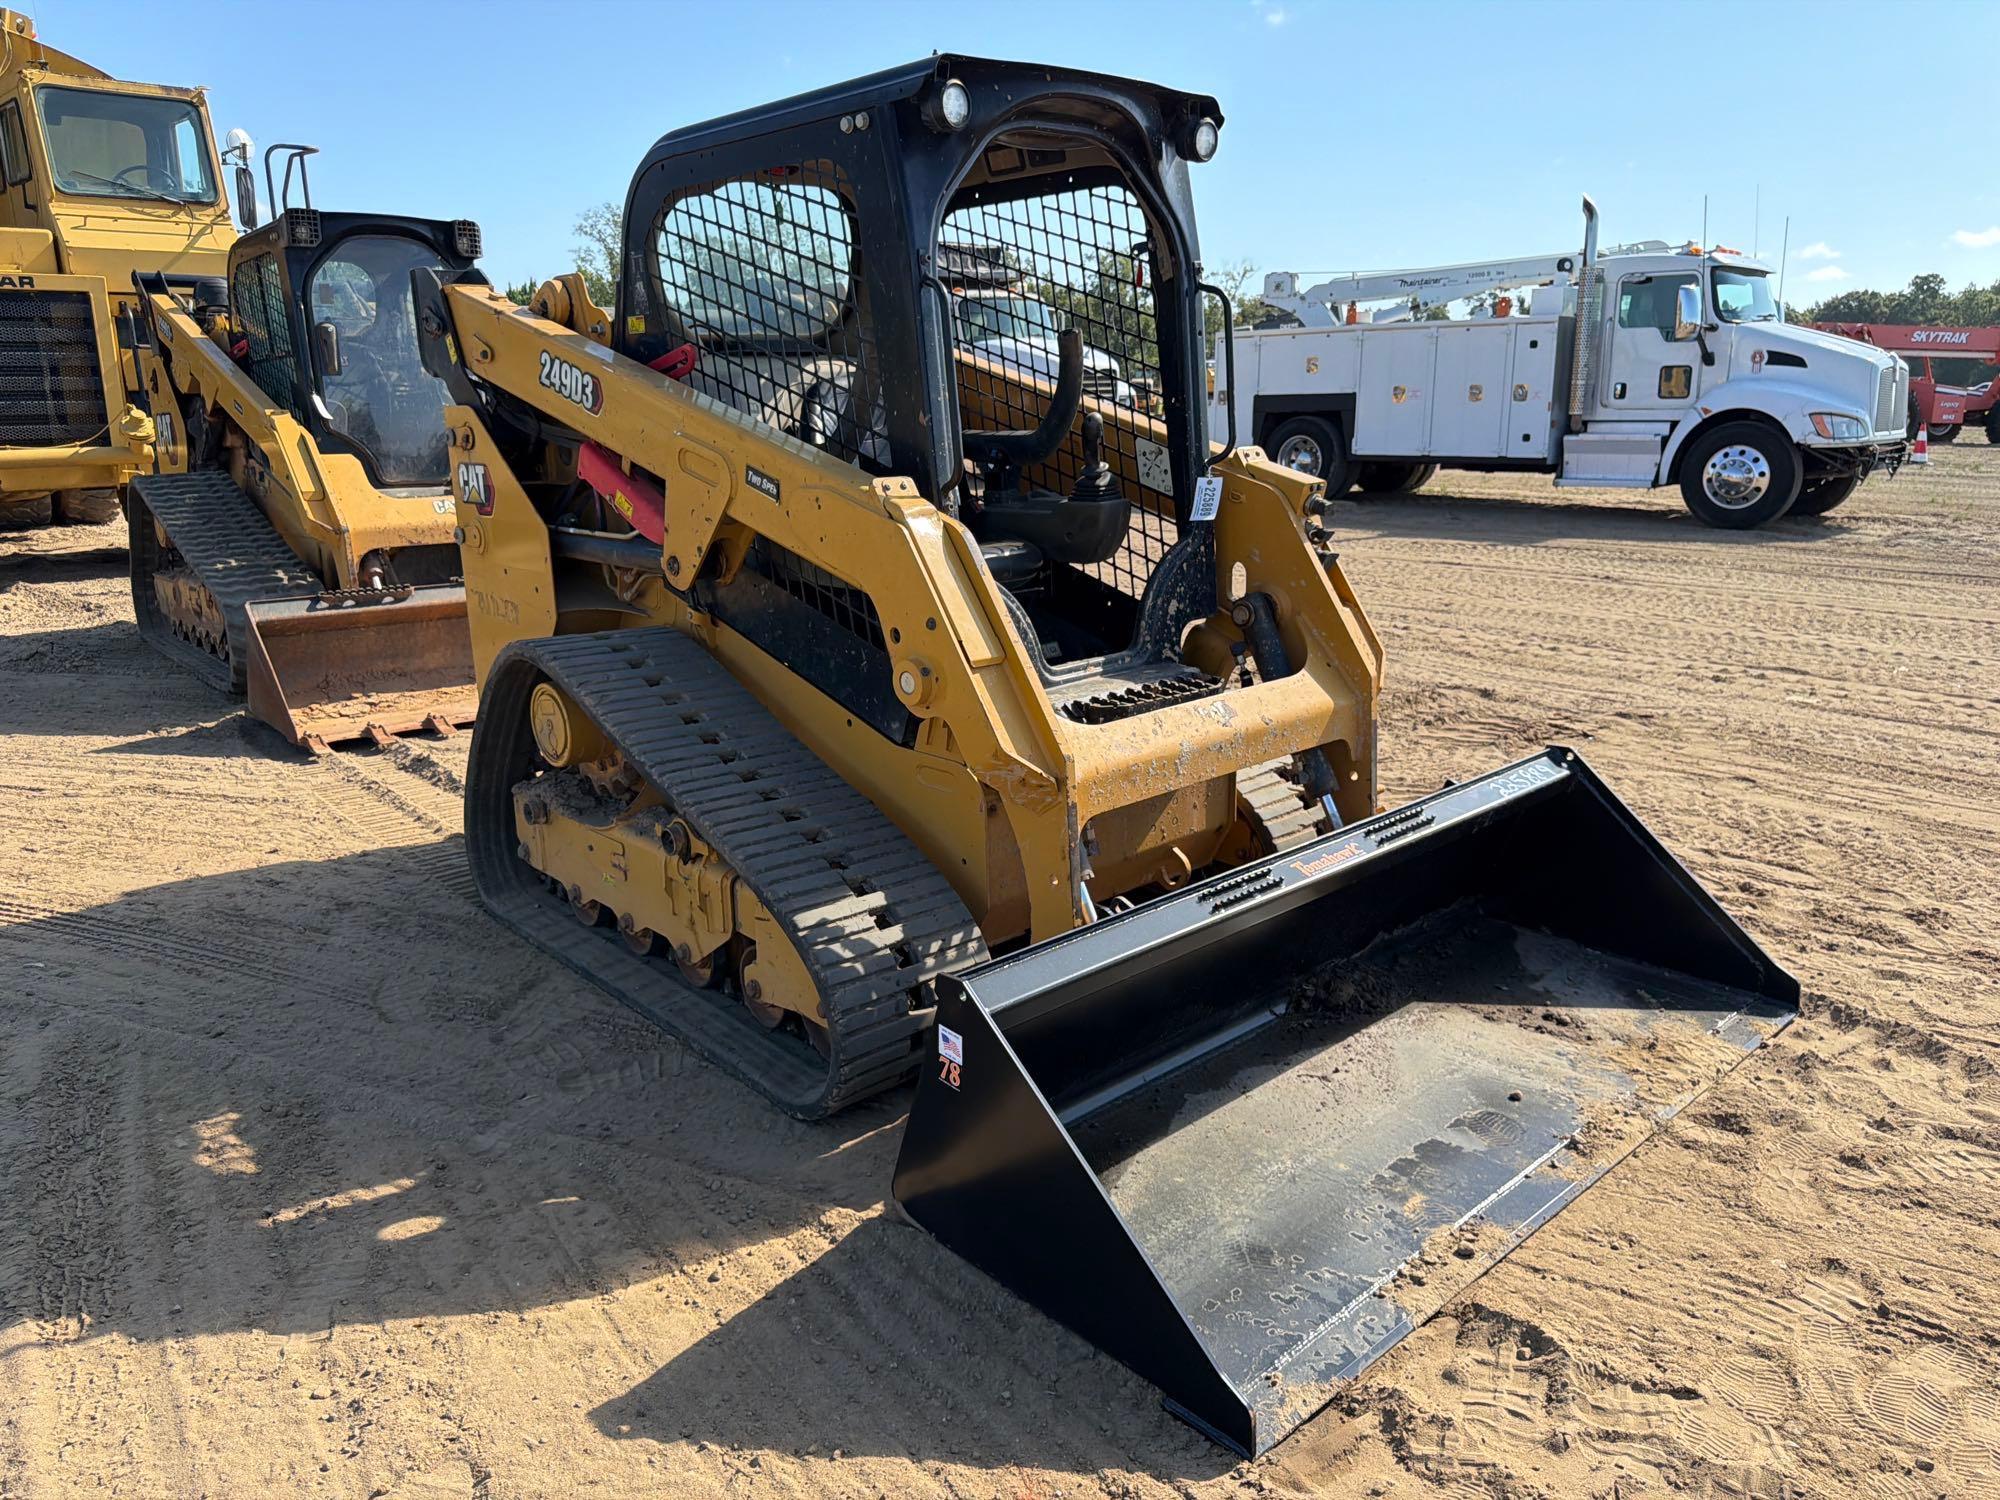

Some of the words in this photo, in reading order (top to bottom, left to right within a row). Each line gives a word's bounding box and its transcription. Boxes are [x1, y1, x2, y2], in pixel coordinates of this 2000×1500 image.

[1911, 330, 1969, 344] SKYTRAK
[539, 350, 594, 410] 249D3
[458, 463, 487, 504] CAT
[432, 500, 456, 515] CA
[1289, 842, 1363, 878] Tomahawk
[938, 1055, 961, 1087] 78
